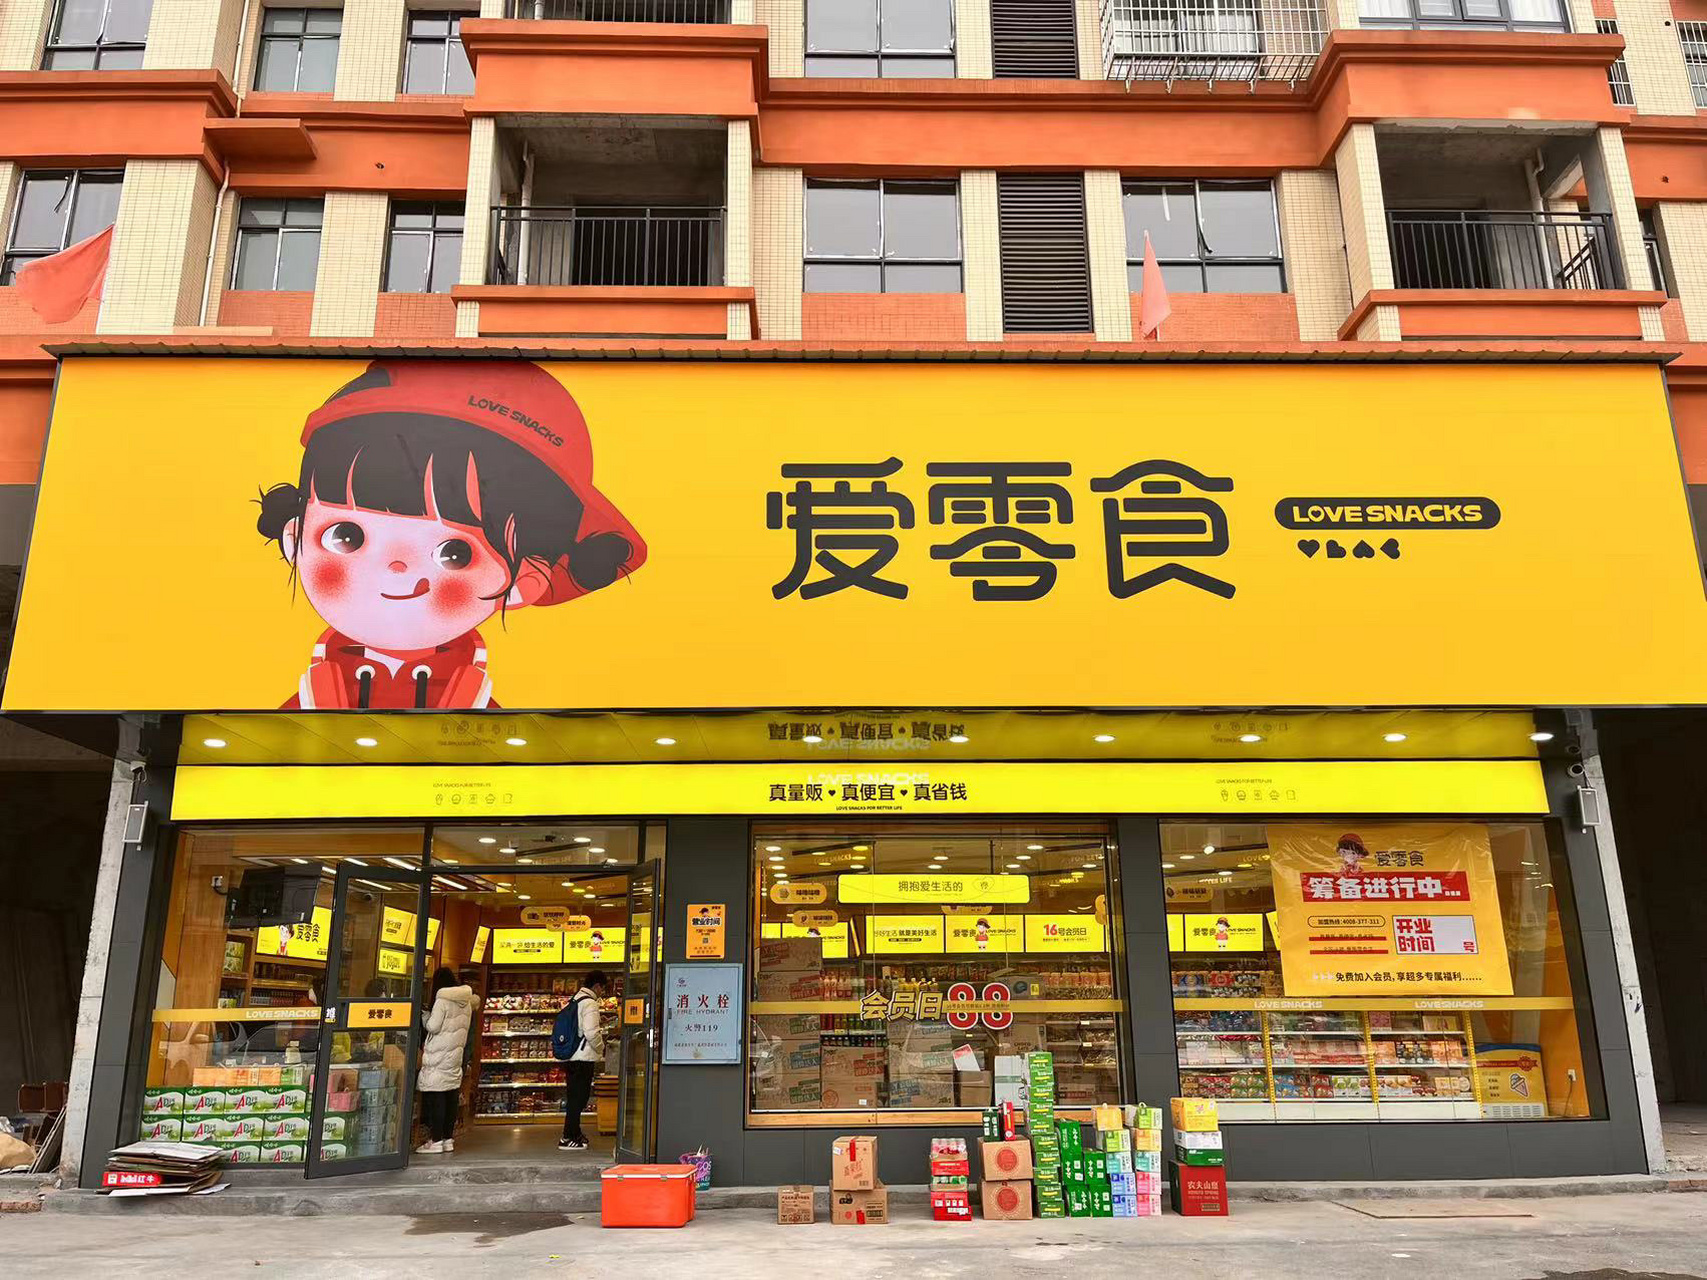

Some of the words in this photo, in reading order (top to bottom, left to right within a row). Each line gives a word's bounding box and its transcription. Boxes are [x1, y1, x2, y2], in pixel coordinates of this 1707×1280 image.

[467, 395, 510, 416] LOVE
[510, 410, 564, 447] SNACKS
[1292, 504, 1363, 523] LOVE
[1366, 504, 1483, 523] SNACKS
[766, 456, 1236, 601] 爱零食
[769, 784, 823, 802] 真量贩
[842, 784, 895, 801] 真便宜
[914, 783, 967, 801] 真省钱
[1375, 851, 1424, 867] 爱零食
[1396, 918, 1432, 934] 开业
[1398, 936, 1435, 952] 时间
[1463, 942, 1474, 952] 号
[676, 994, 729, 1009] 消火栓
[860, 989, 944, 1021] 会员日
[947, 982, 1013, 1030] 88
[1254, 1001, 1281, 1009] LOVE
[1281, 1001, 1323, 1009] SNACKS
[246, 1009, 273, 1018] LOVE
[368, 1008, 393, 1019] 爱零食
